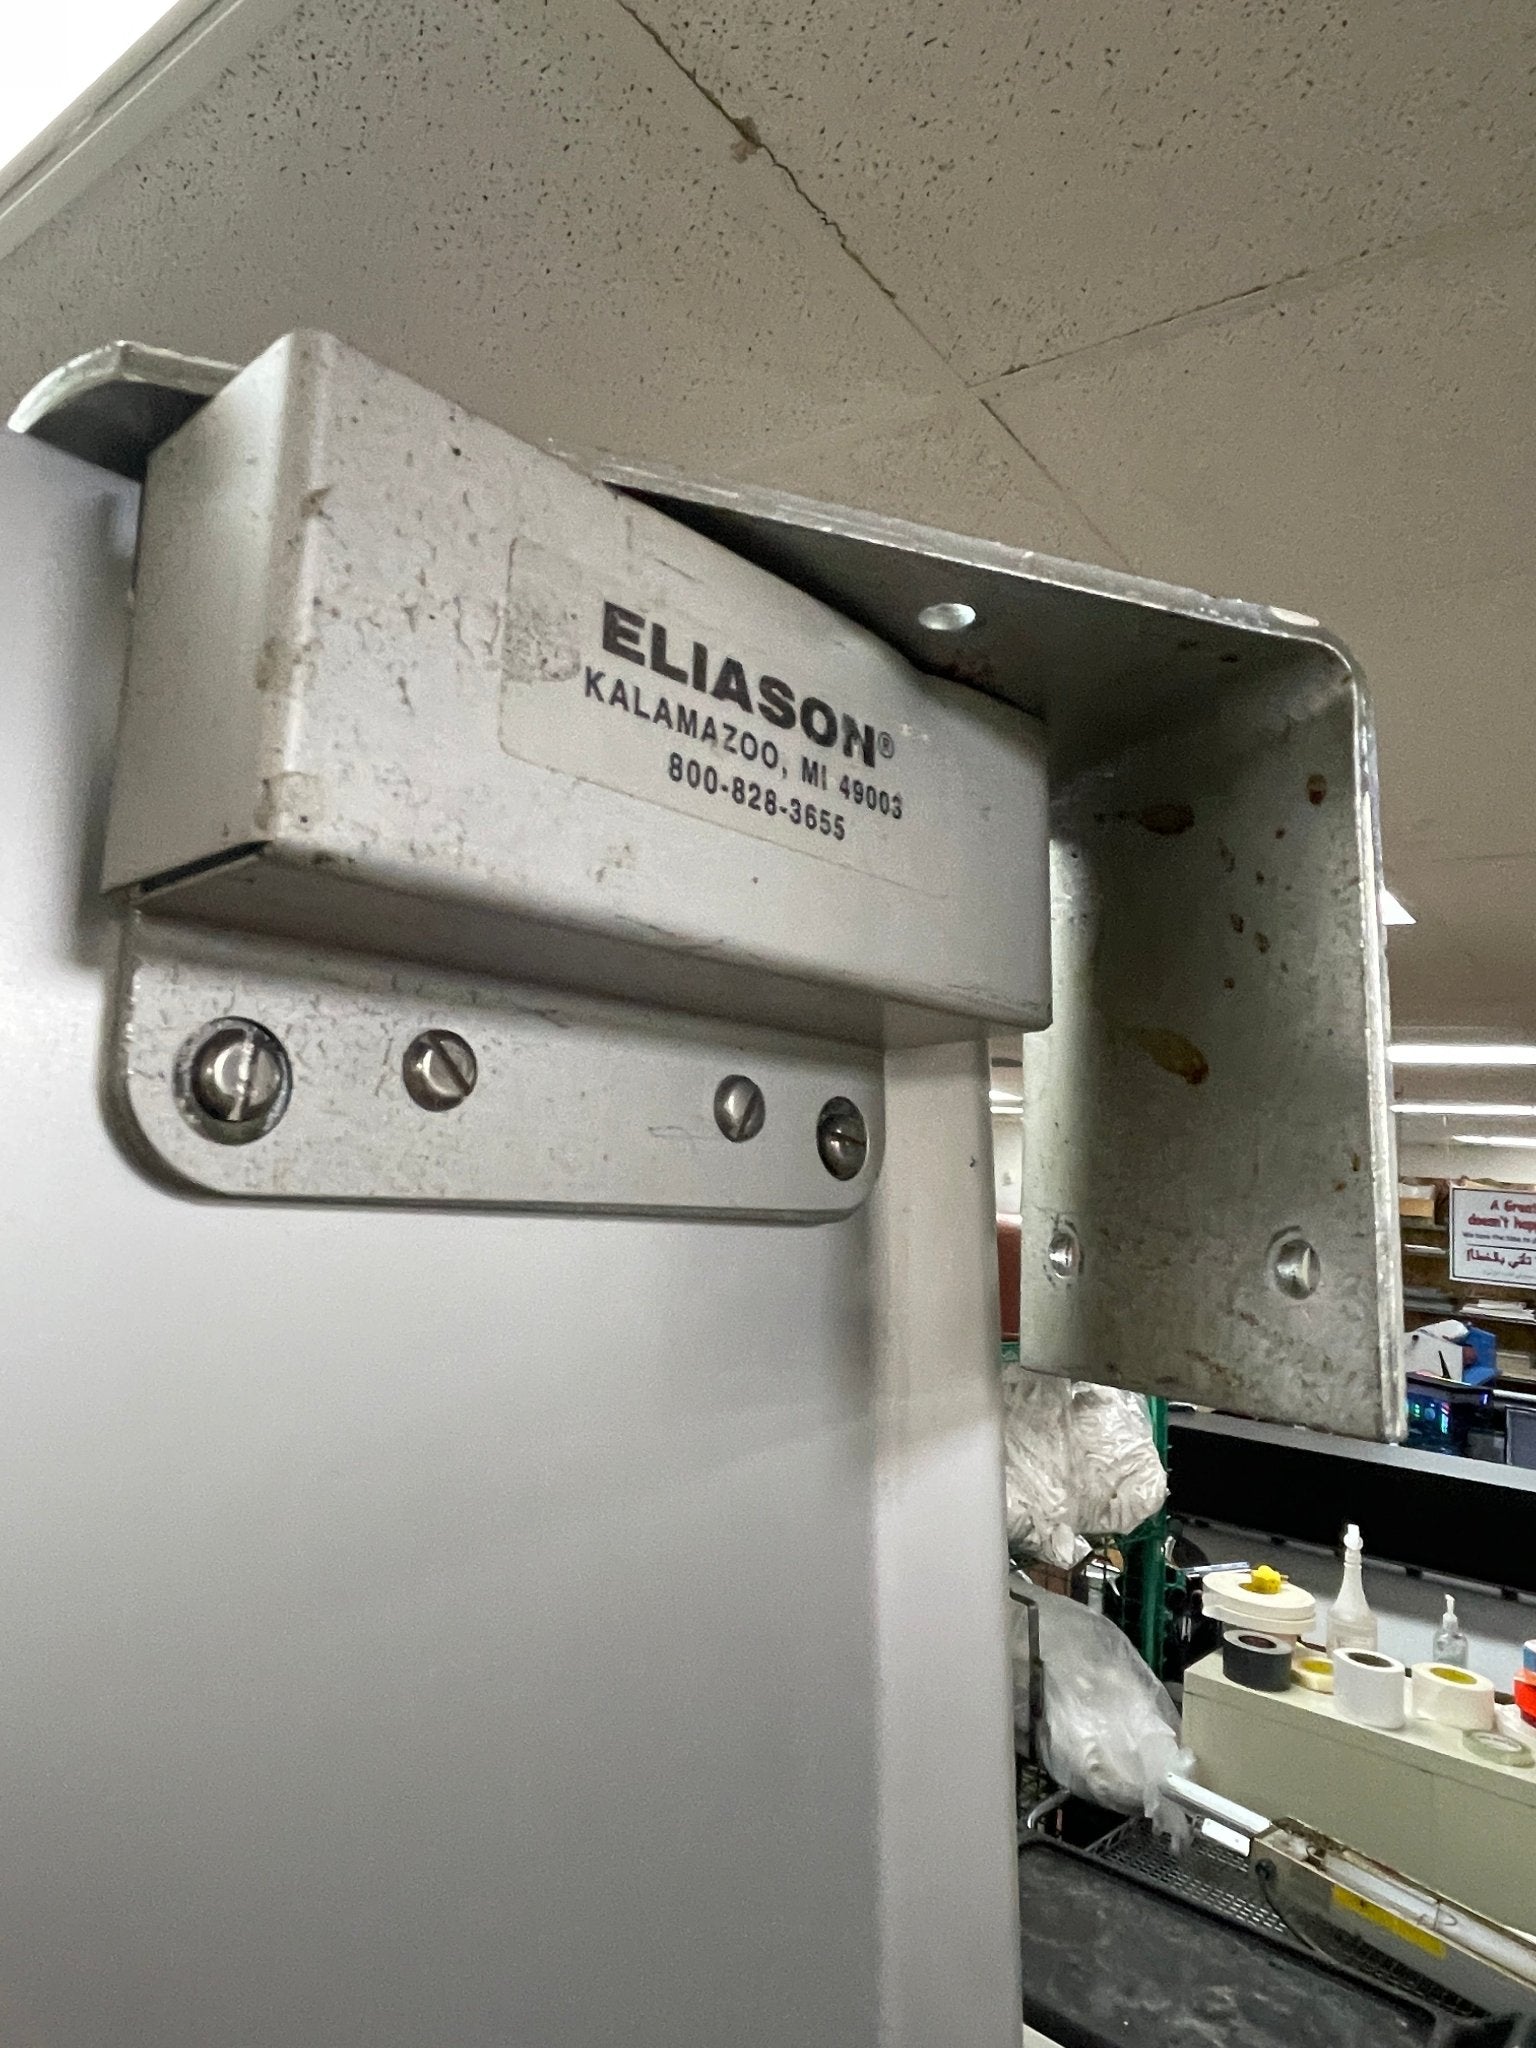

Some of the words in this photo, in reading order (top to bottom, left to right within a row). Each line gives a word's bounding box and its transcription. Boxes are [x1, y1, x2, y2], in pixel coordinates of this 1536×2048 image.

[585, 666, 788, 779] KALAMAZOO,
[802, 757, 828, 791] MI
[840, 775, 903, 819] 49003
[669, 752, 845, 841] 800-828-3655
